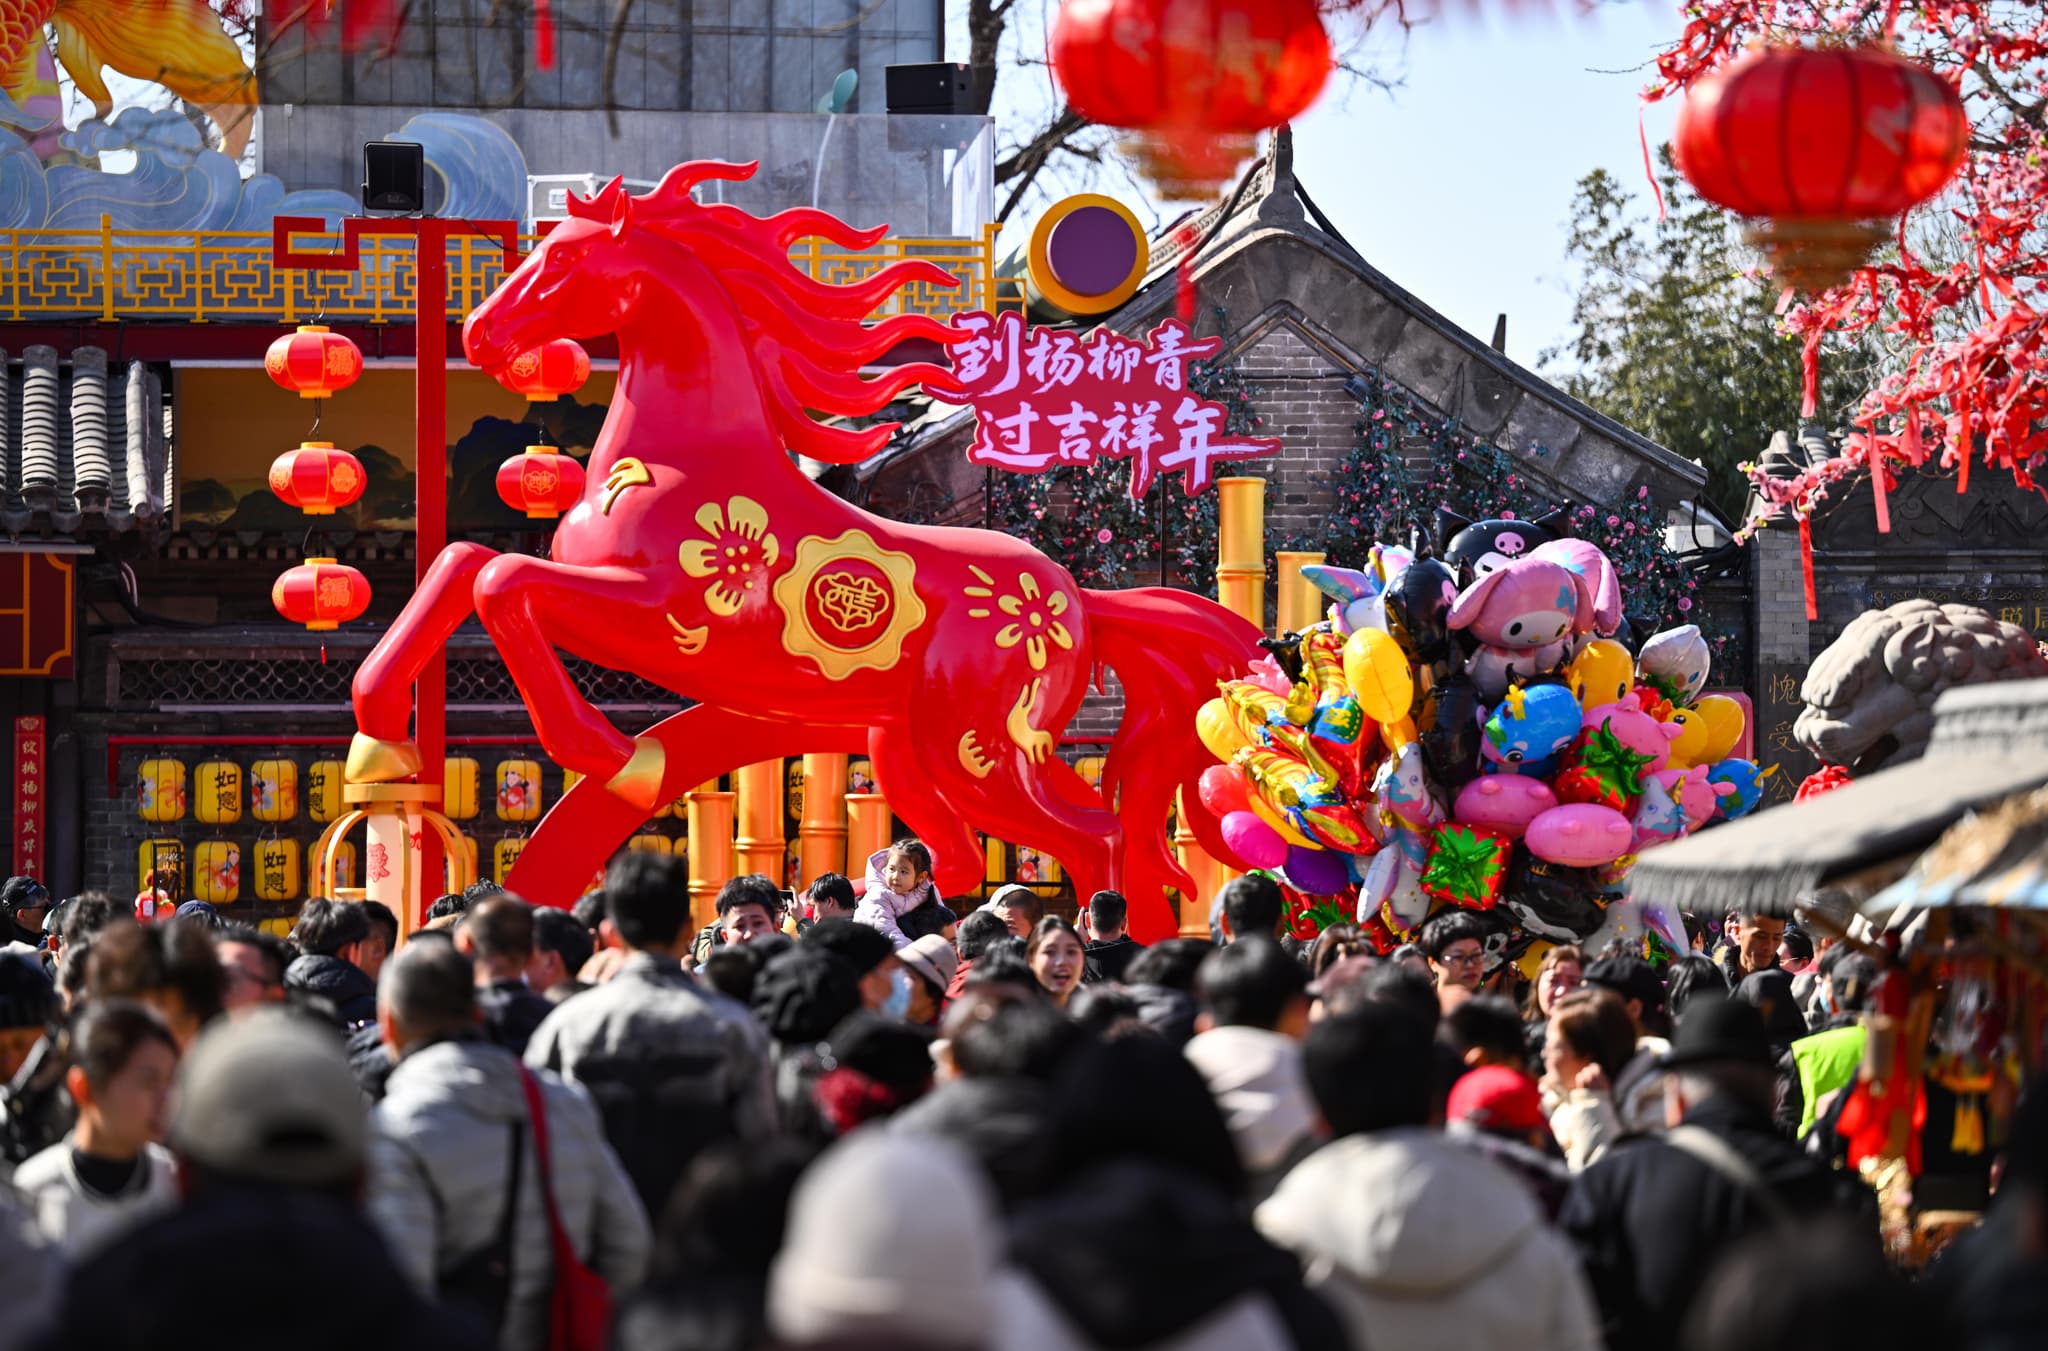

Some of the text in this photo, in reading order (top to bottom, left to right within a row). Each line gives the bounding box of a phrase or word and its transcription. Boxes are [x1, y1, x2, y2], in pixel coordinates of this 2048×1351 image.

[927, 316, 1216, 398] 到杨柳青
[975, 397, 1280, 491] 过吉祥年
[319, 576, 350, 607] 福
